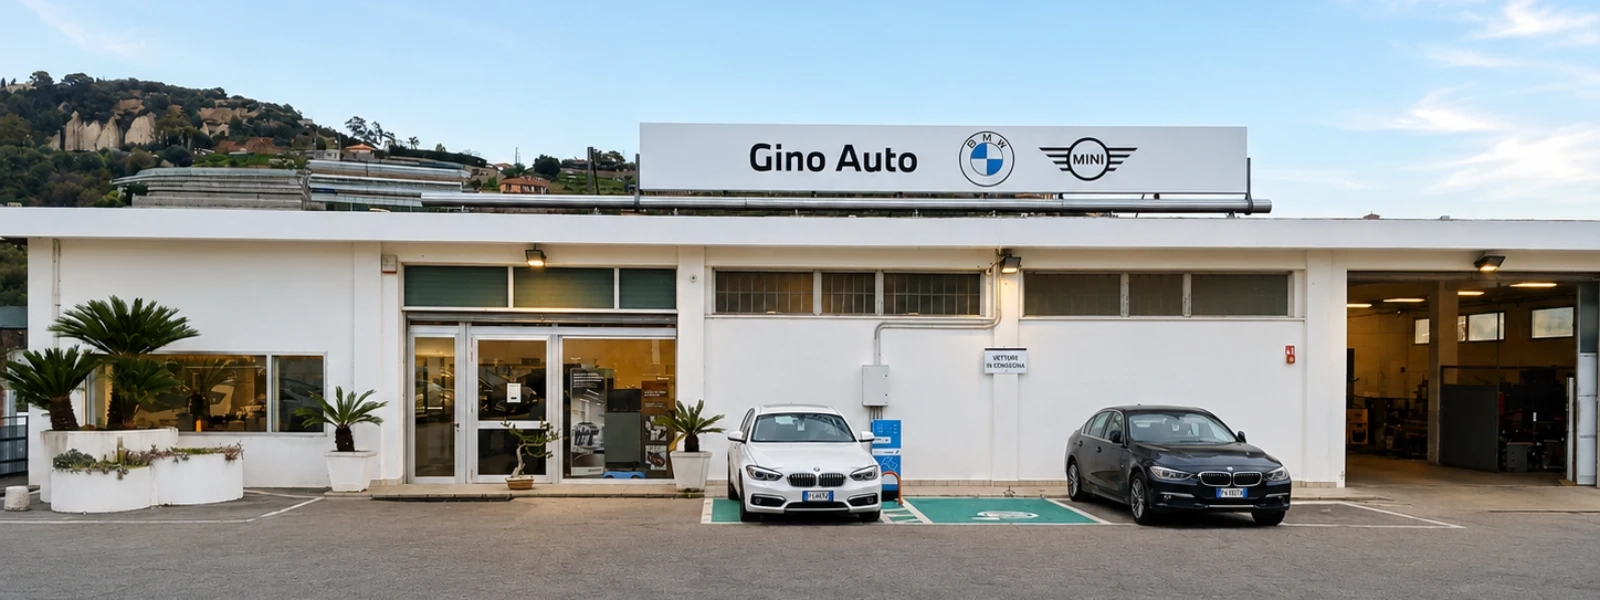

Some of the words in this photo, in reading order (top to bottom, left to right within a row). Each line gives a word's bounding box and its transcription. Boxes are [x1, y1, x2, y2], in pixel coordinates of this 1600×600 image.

[967, 133, 1007, 149] BMW
[750, 143, 826, 172] Gino
[835, 144, 918, 172] Auto
[1073, 154, 1104, 165] MINI
